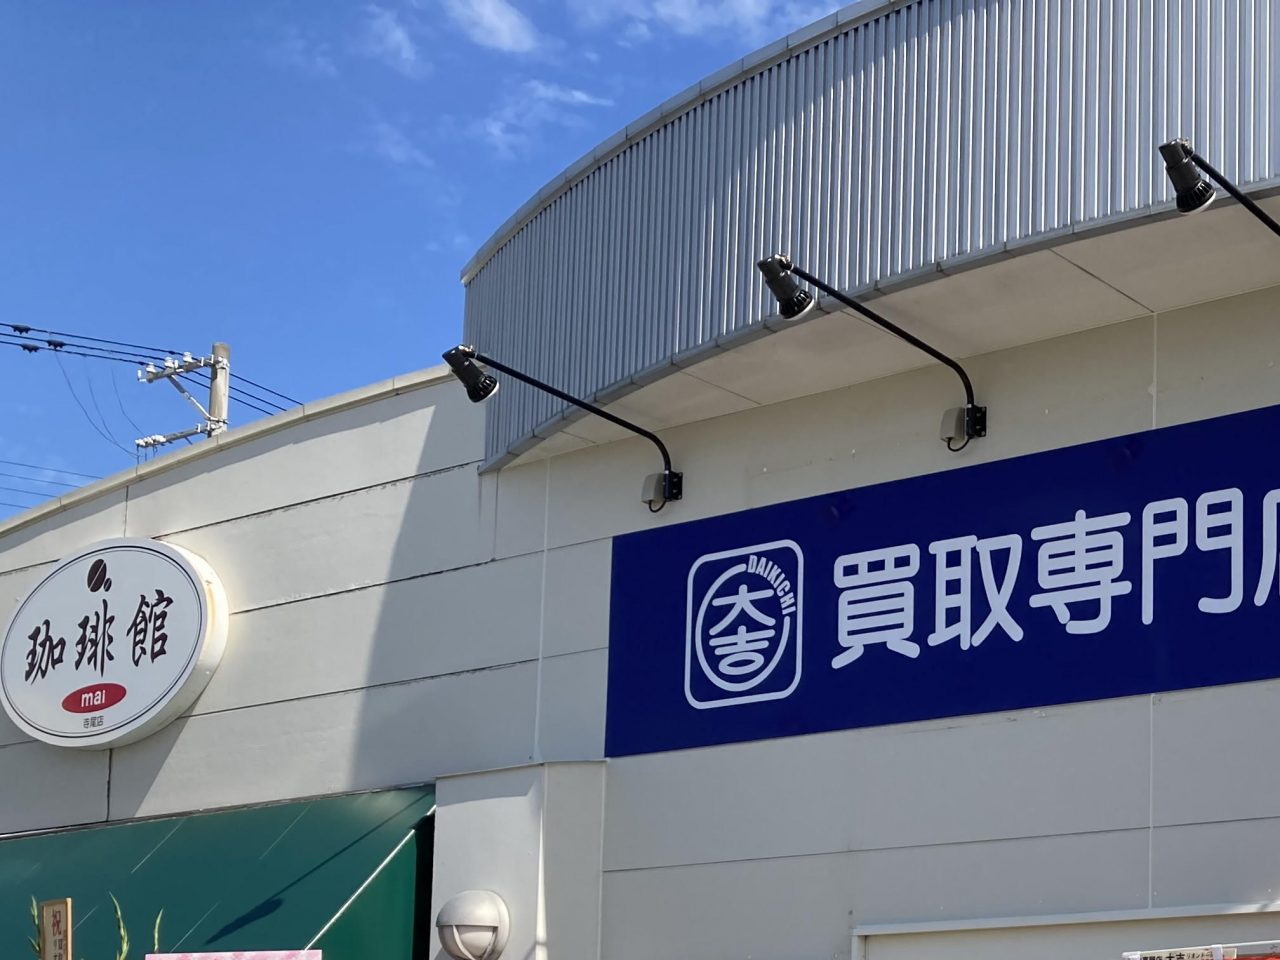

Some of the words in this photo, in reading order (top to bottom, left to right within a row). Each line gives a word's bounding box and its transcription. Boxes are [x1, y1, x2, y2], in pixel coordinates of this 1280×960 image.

[747, 555, 796, 615] DAIKICHI
[24, 588, 174, 686] 珈琲館
[709, 584, 776, 675] 大吉
[81, 689, 106, 708] mai
